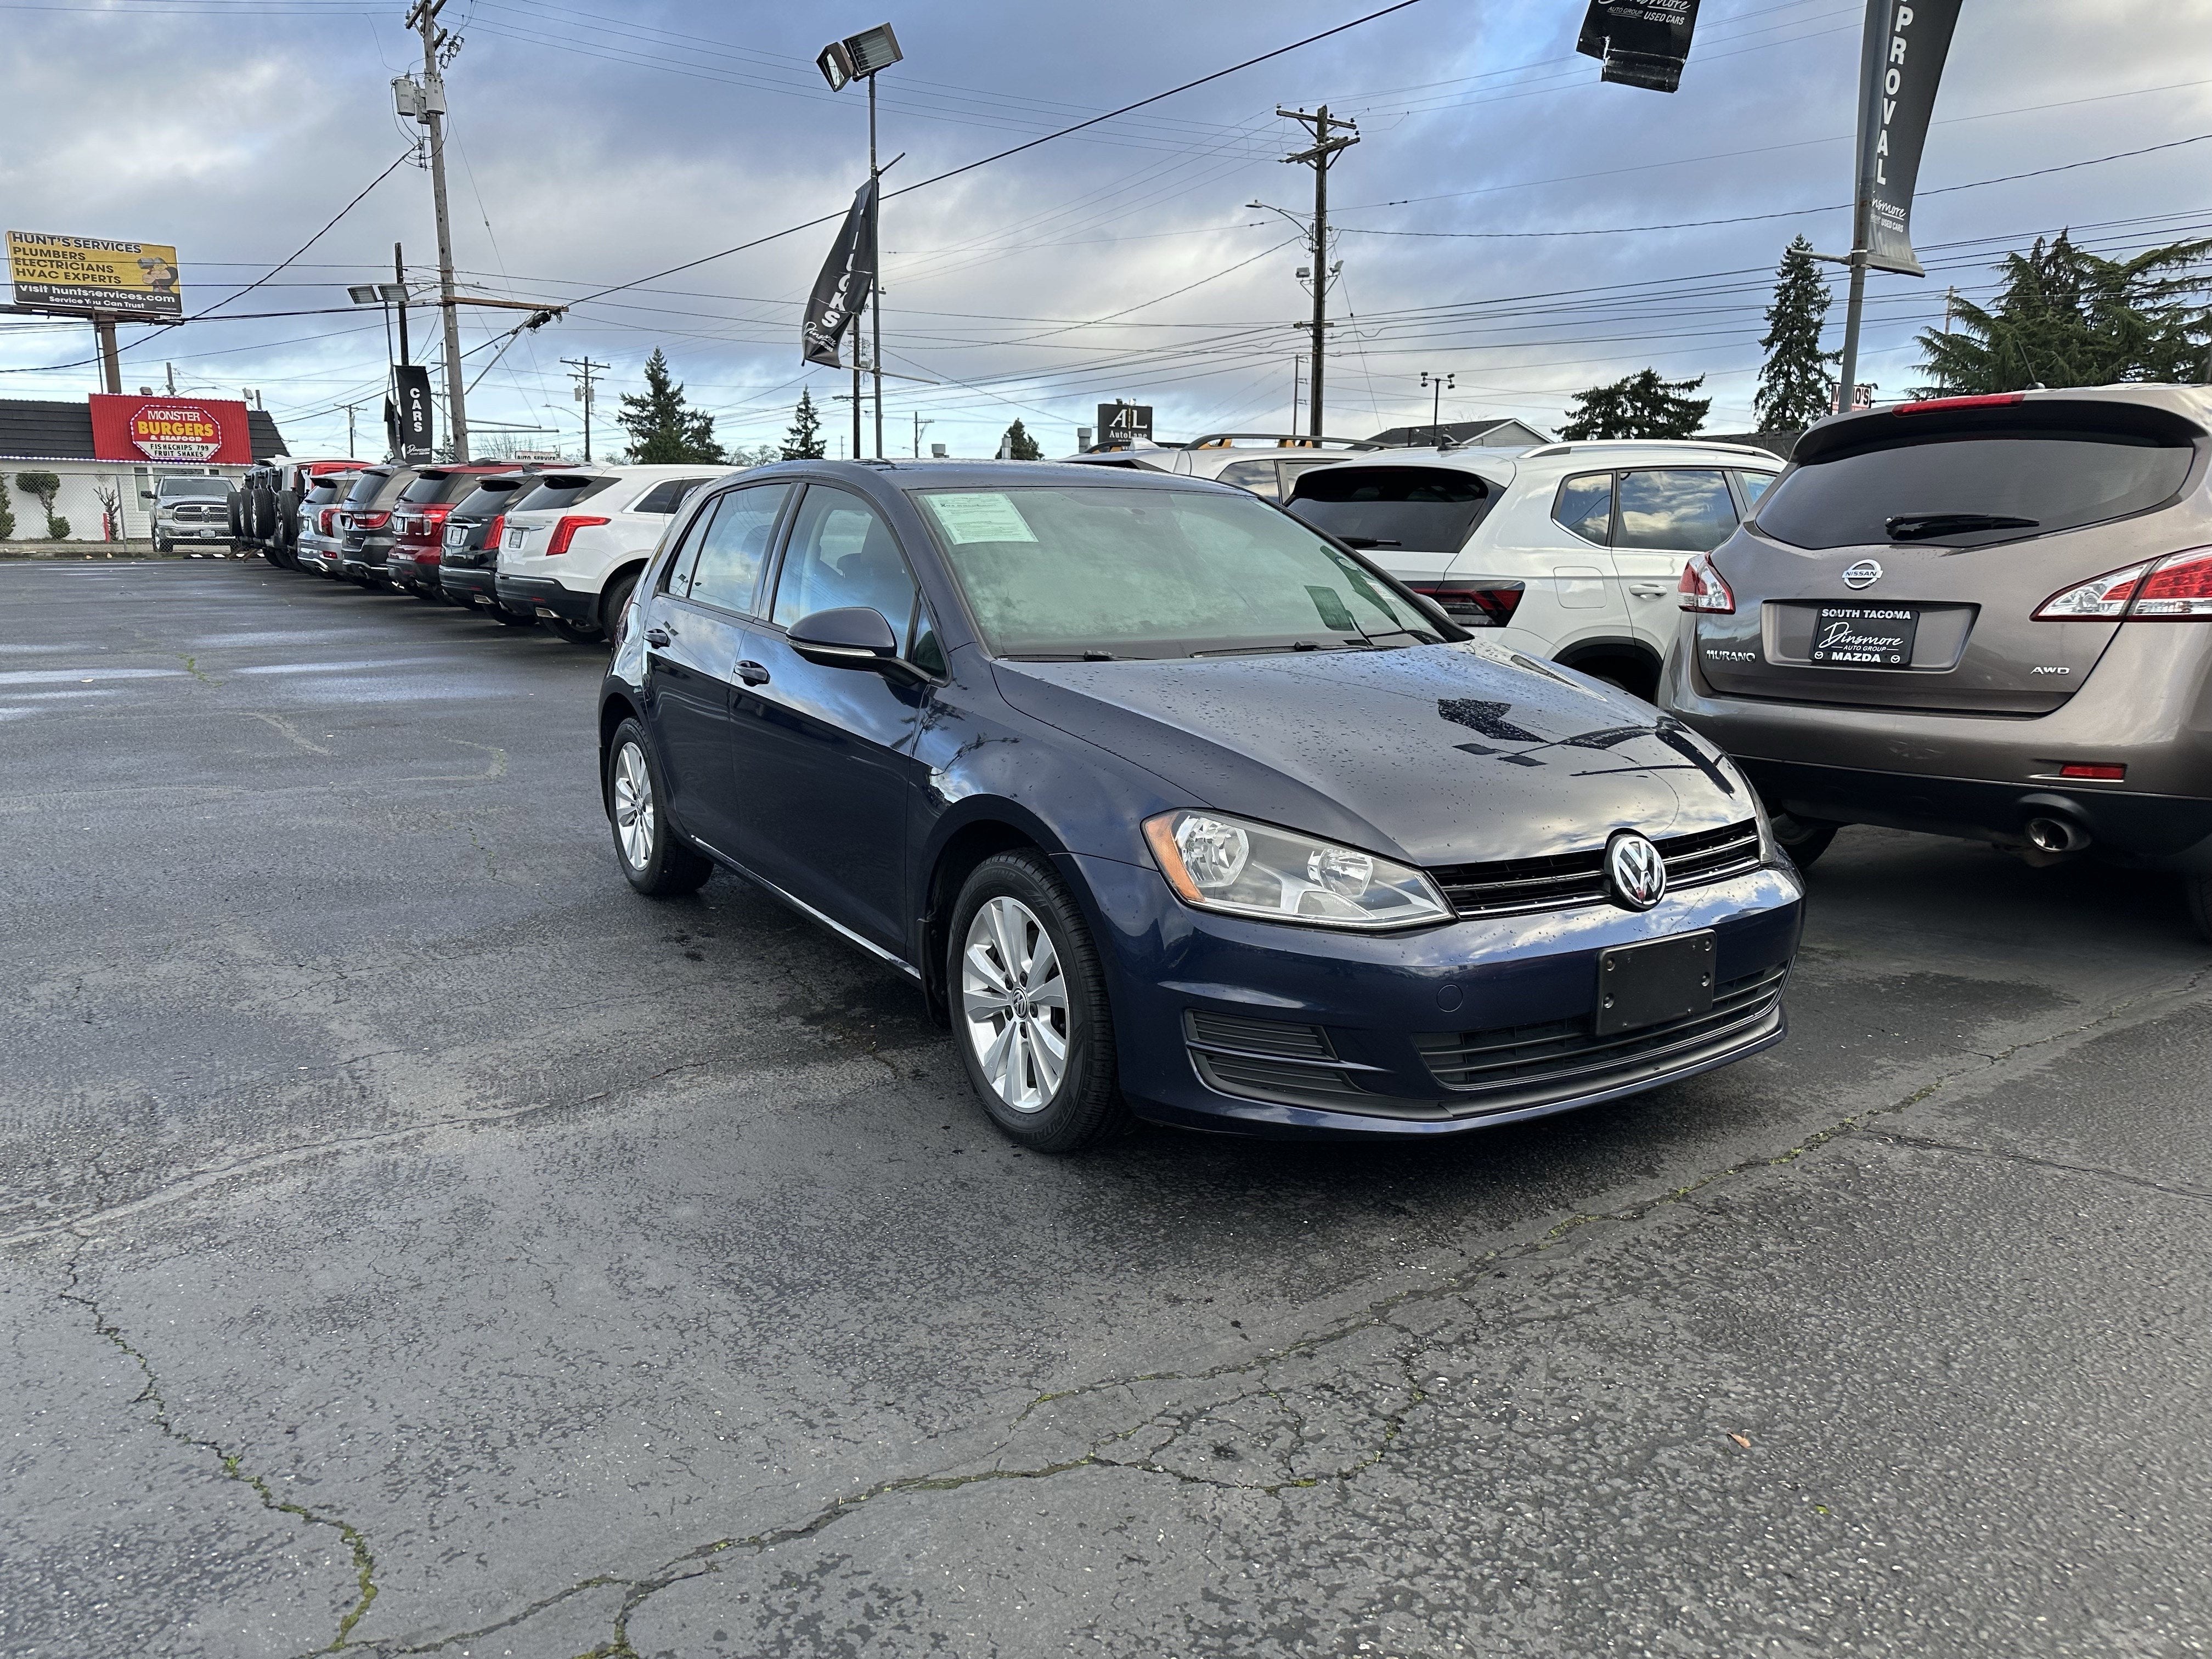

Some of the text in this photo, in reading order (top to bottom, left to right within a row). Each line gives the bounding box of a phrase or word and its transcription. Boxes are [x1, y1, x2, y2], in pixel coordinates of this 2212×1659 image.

[1644, 12, 1667, 21] USED
[1666, 14, 1685, 25] CARS
[1877, 0, 1914, 185] PROVAL
[12, 233, 142, 253] HUNT'S SERVICES
[13, 246, 86, 261] PLUMBERS
[14, 257, 114, 273] ELECTRICIANS
[16, 268, 121, 284] HVAC EXPERTS
[19, 285, 175, 302] Visit huntsservices.com
[49, 296, 83, 304] Service
[147, 410, 201, 422] MONSTER
[409, 387, 422, 432] CARS
[137, 421, 214, 437] BURGERS
[1821, 608, 1911, 619] SOUTH TACOMA
[1819, 622, 1903, 648] Dinsmore
[1706, 650, 1756, 662] MURANO
[1831, 652, 1881, 663] MAZDA
[2030, 666, 2070, 675] AWD
